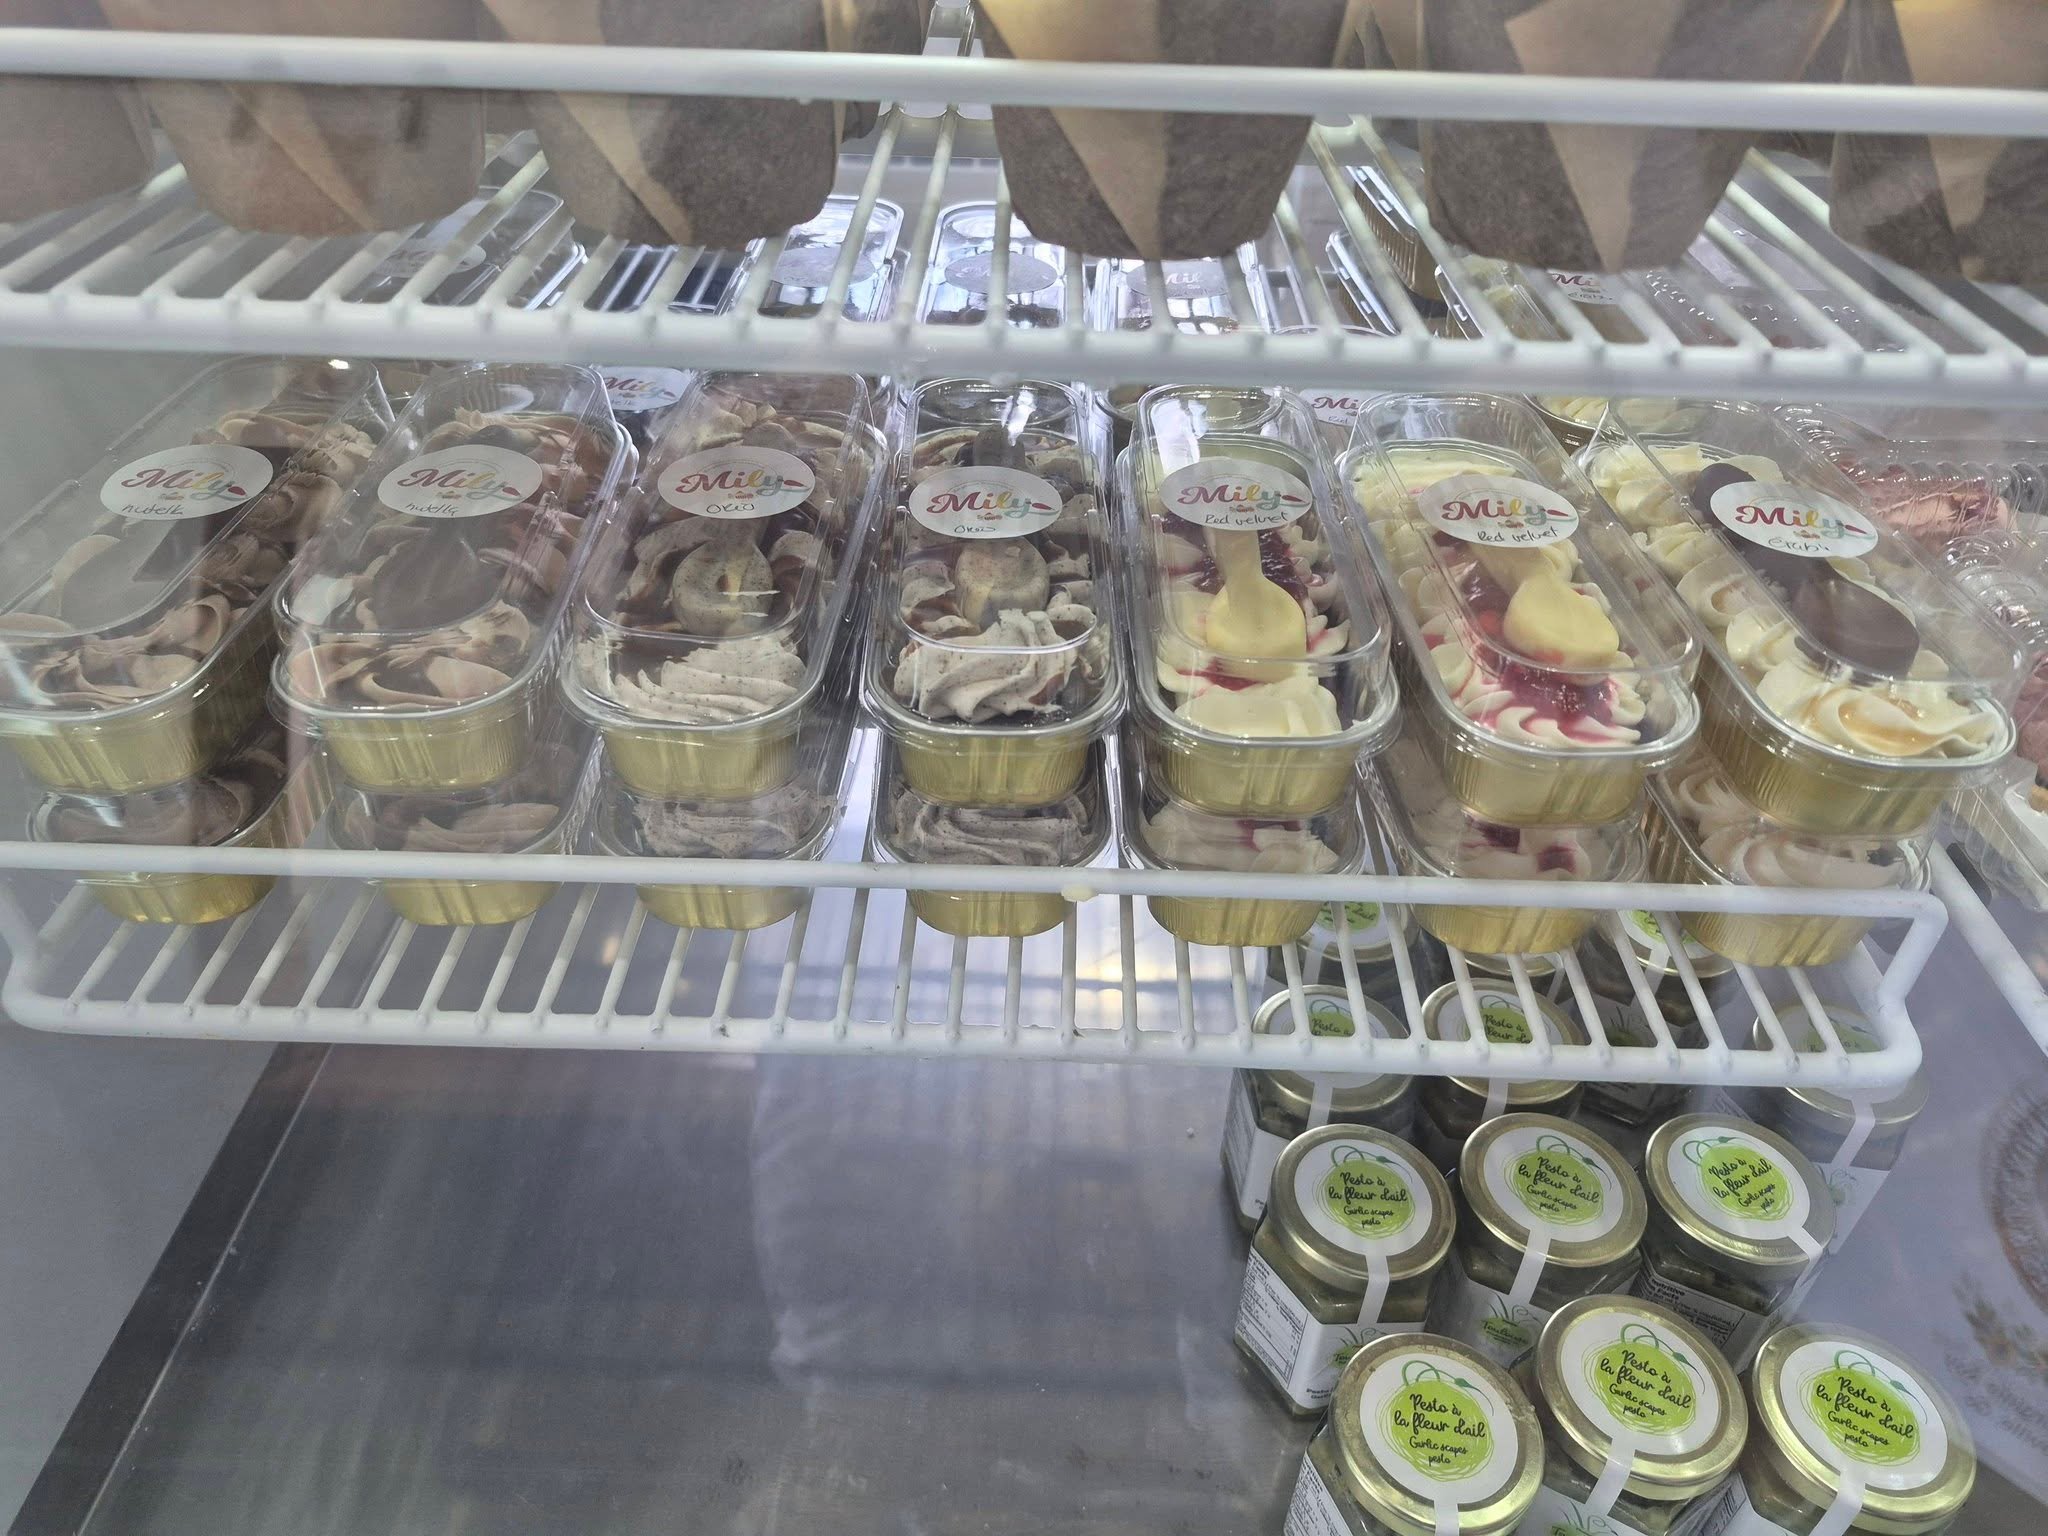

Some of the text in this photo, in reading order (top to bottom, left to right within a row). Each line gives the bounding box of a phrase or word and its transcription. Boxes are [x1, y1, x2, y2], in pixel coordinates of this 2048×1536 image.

[1312, 396, 1359, 410] Mi
[121, 468, 247, 501] Mily
[397, 468, 521, 501] Mily
[675, 469, 811, 497] Mily
[1177, 484, 1311, 510] Mily
[926, 491, 1060, 519] Mily
[1441, 498, 1577, 526] Mily
[1735, 505, 1876, 539] Mily
[1340, 1173, 1385, 1186] Pesto à
[1518, 1164, 1531, 1178] la
[1534, 1170, 1567, 1189] fleur
[1538, 1156, 1582, 1183] Pesto à
[1709, 1162, 1737, 1179] Pesto
[1329, 1187, 1342, 1200] la
[1344, 1187, 1376, 1204] fleur
[1600, 1358, 1614, 1375] la
[1616, 1366, 1655, 1391] fleur
[1622, 1350, 1671, 1384] Pesto à
[1410, 1394, 1461, 1416] Pesto à
[1816, 1384, 1831, 1402] la
[1835, 1393, 1875, 1419] fleur
[1838, 1376, 1891, 1412] Pesto à
[1394, 1410, 1409, 1427] la
[1412, 1412, 1450, 1435] fleur
